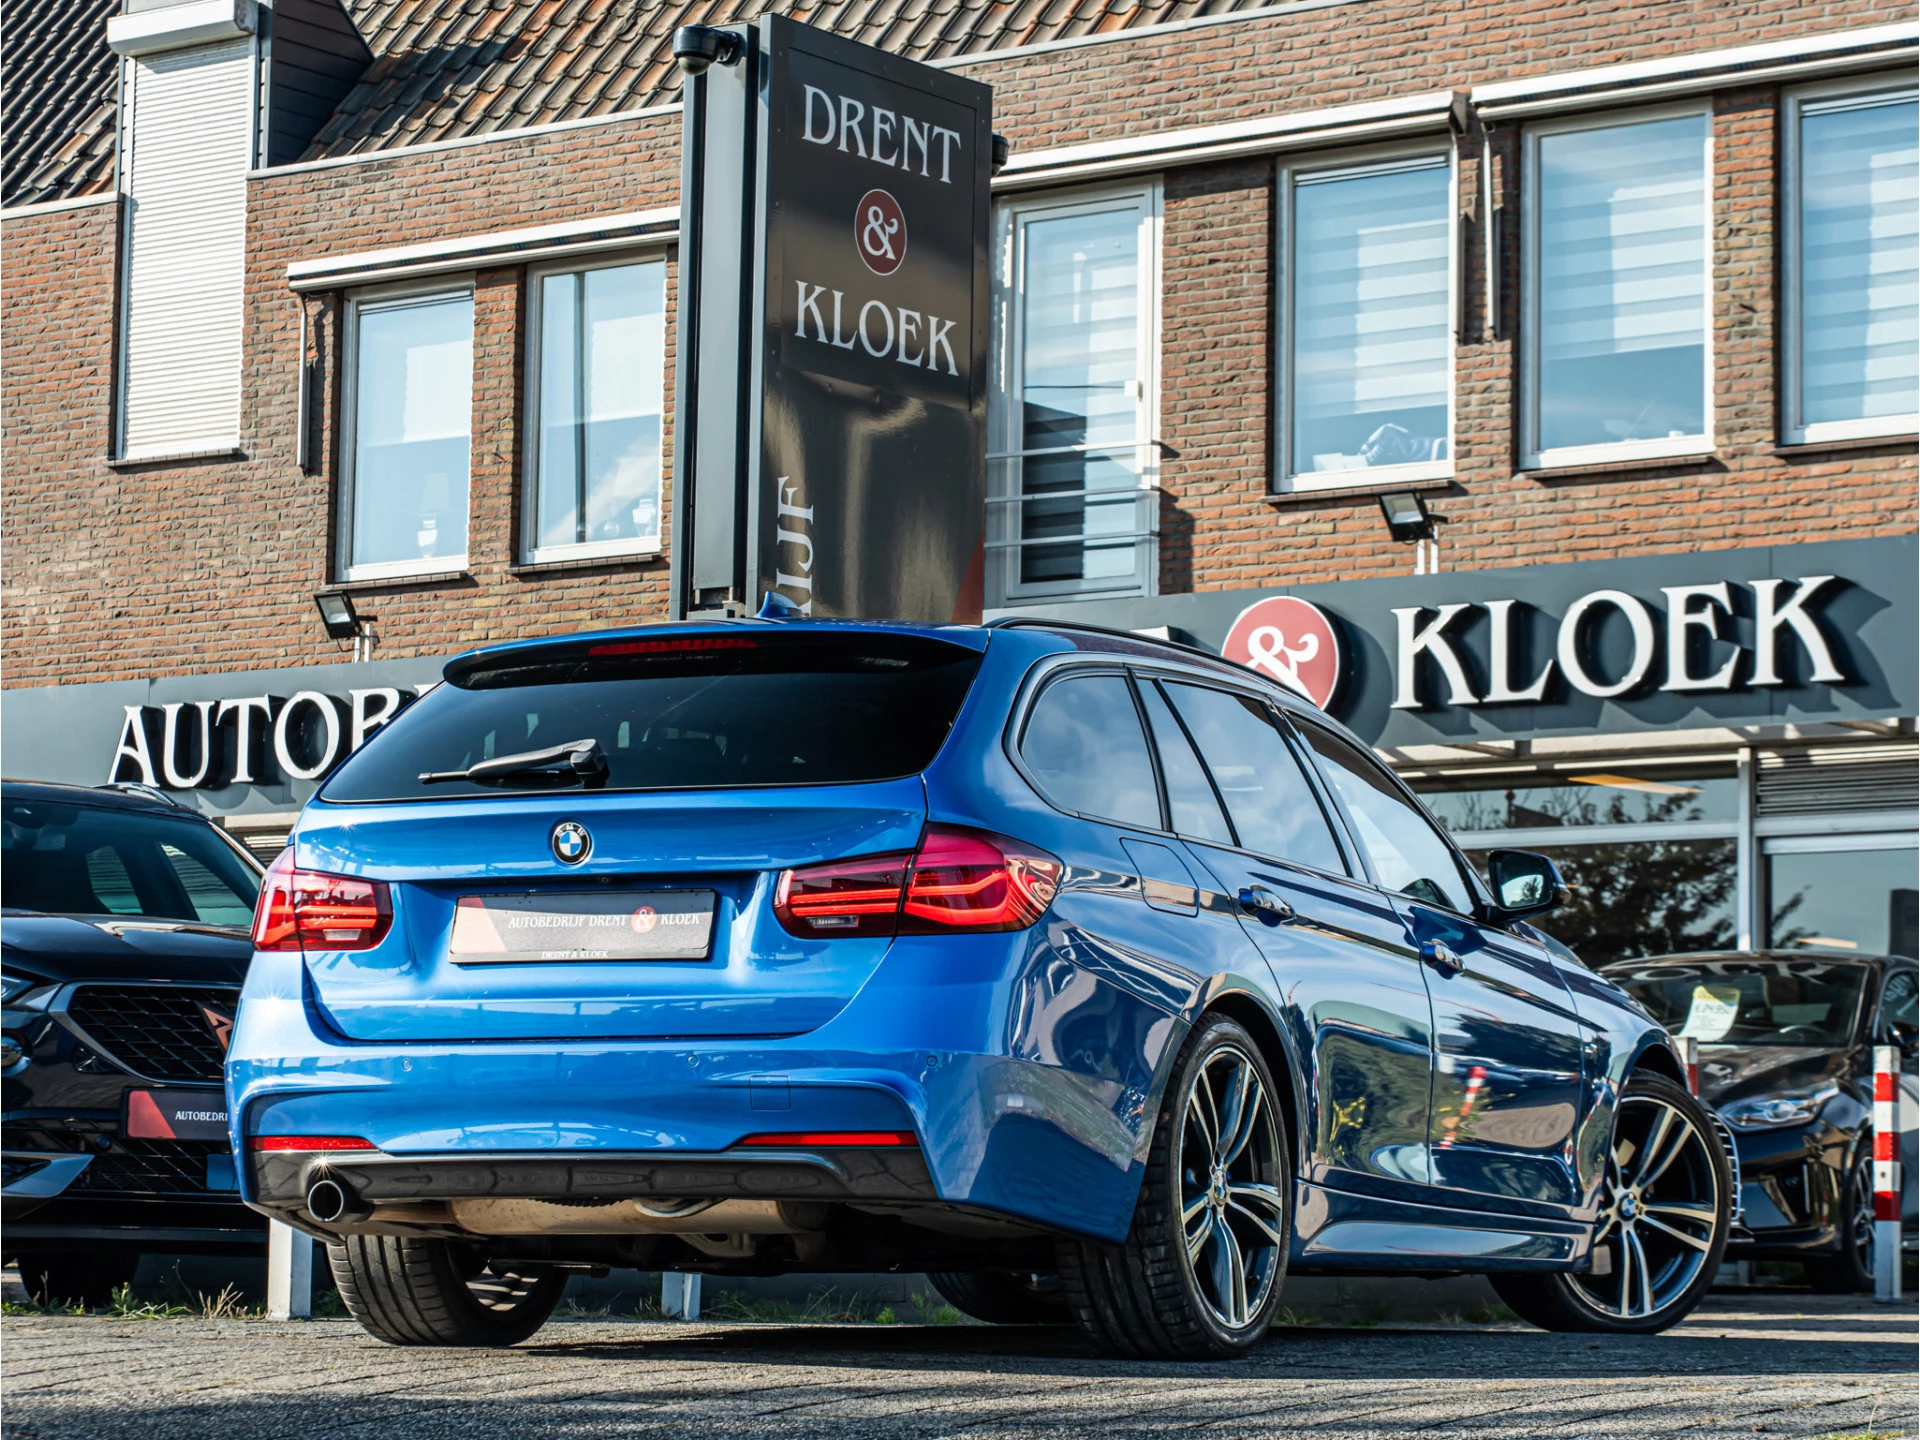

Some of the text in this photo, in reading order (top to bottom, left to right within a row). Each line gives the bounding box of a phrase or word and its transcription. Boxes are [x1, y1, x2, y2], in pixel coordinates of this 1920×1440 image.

[801, 83, 961, 184] DRENT
[862, 205, 899, 261] &
[794, 279, 959, 377] KLOEK
[775, 476, 814, 617] IJF
[1390, 574, 1845, 709] KLOEK
[556, 823, 586, 838] BMW
[508, 909, 700, 930] AUTOBEDRIJF DRENT & KLOEK
[541, 950, 609, 960] DRENT & KLOEK
